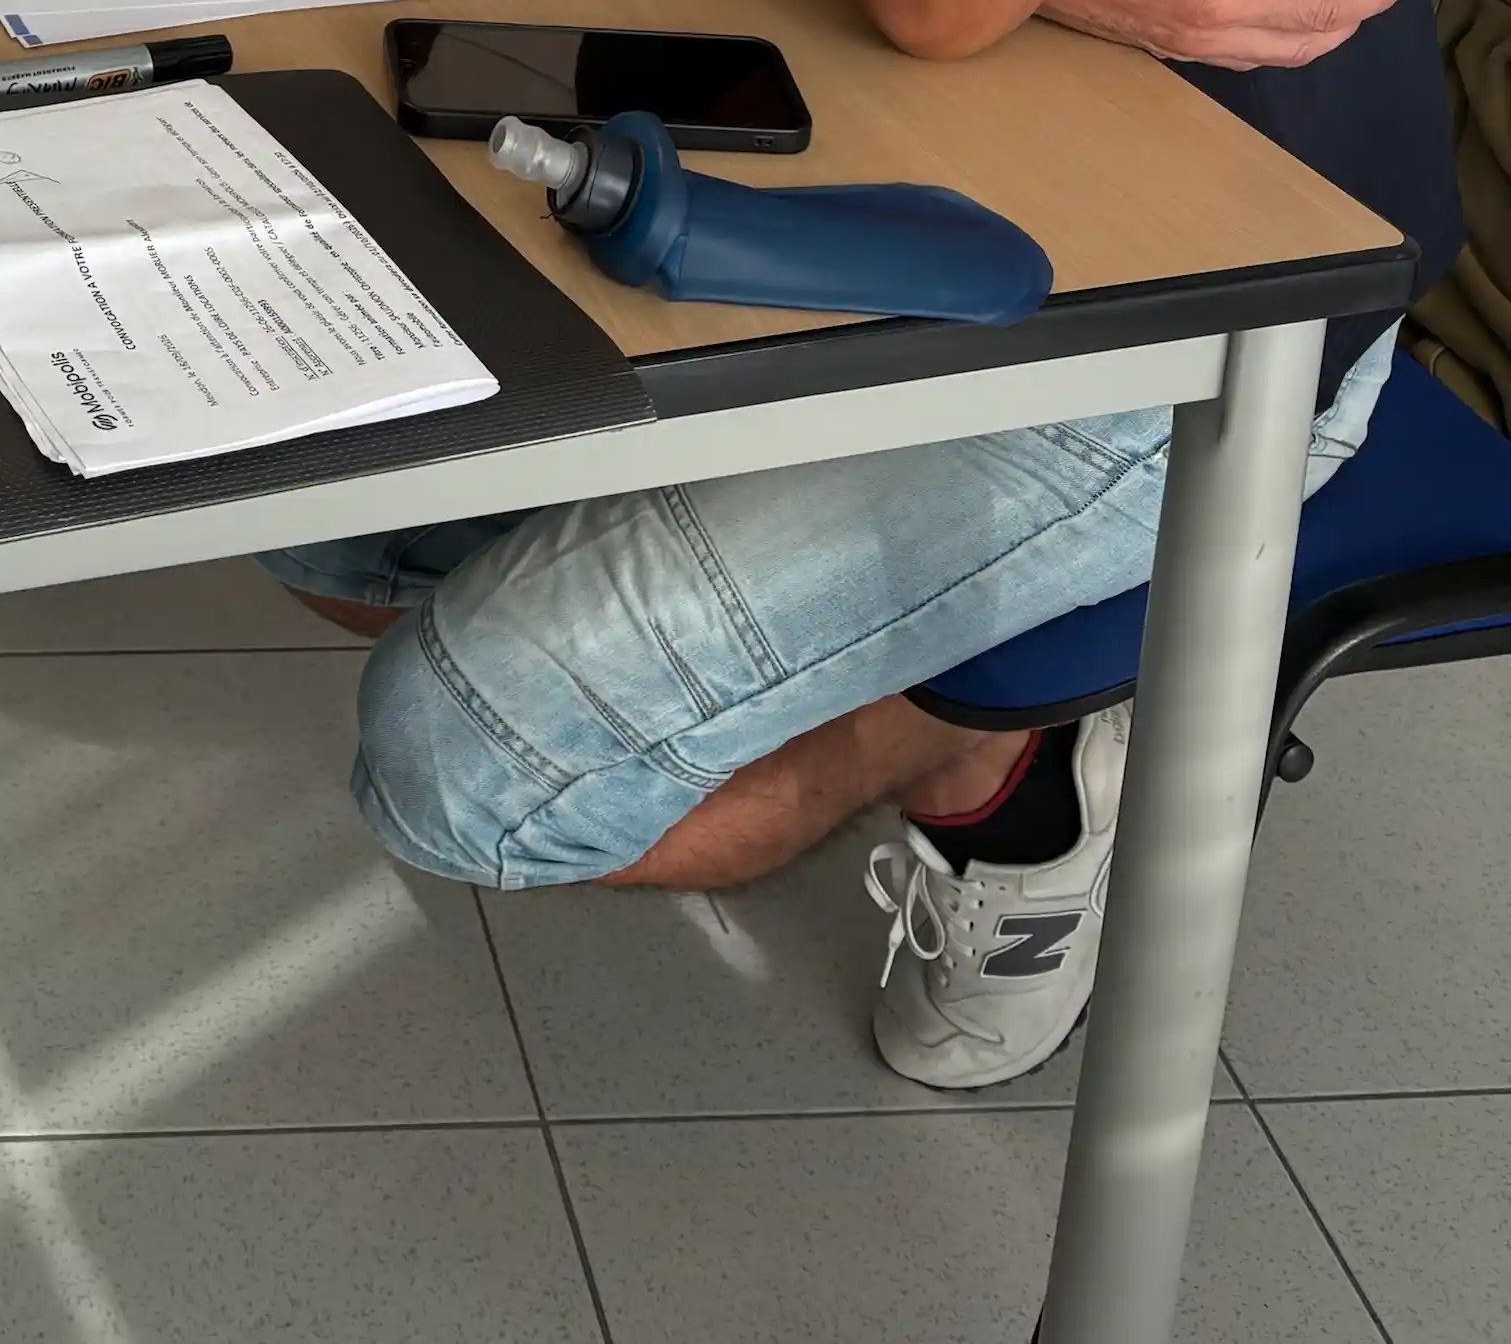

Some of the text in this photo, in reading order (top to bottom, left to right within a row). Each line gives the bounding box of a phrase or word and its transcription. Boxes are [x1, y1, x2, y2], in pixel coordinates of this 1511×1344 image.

[88, 70, 130, 91] BIC
[69, 244, 95, 280] VOTRE
[144, 244, 173, 279] MORLIER
[84, 280, 99, 289] A
[165, 279, 194, 312] Monsieur
[182, 273, 217, 312] LOCATIONS
[89, 288, 138, 350] CONVOCATION
[186, 311, 202, 321] de
[209, 312, 232, 331] LOIRE
[224, 329, 241, 341] DE
[231, 339, 253, 356] PAYS
[370, 323, 407, 355] Formation
[366, 345, 387, 360] Titre
[43, 349, 110, 414] Mobipolis
[221, 357, 261, 396] Convocation
